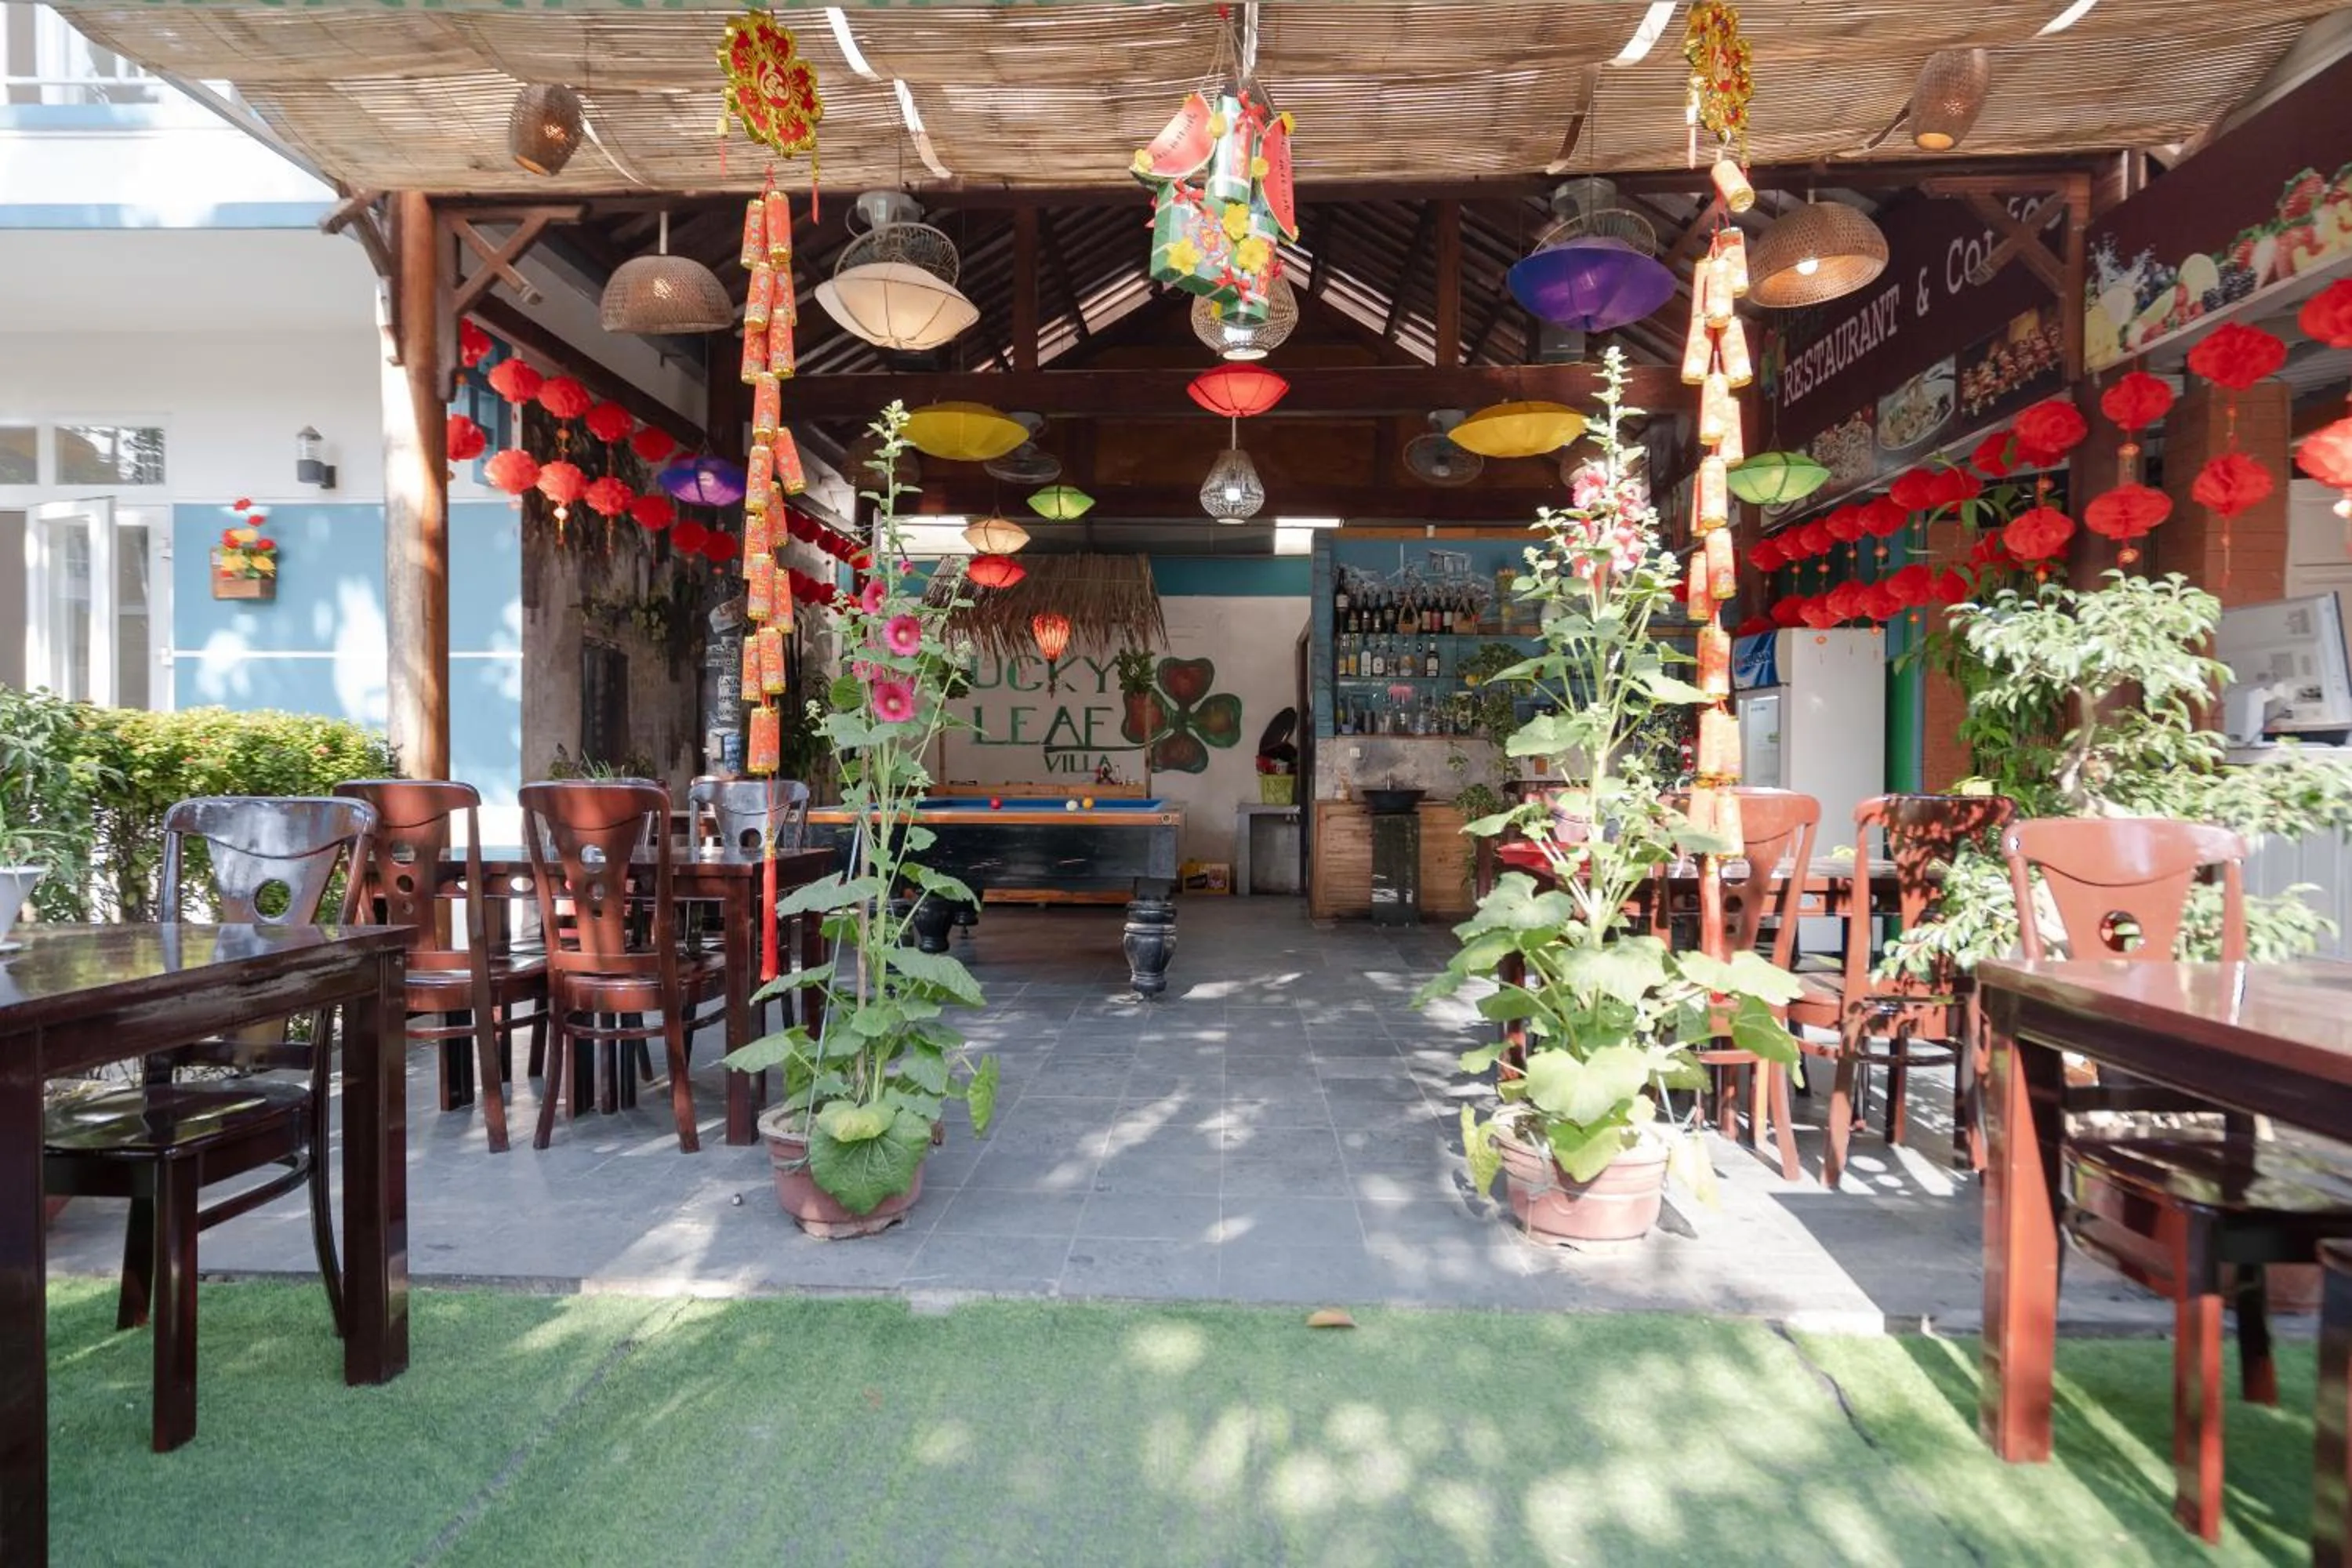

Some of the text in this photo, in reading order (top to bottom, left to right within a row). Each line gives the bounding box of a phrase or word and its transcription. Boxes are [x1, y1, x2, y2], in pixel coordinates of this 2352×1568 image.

[1784, 288, 1899, 406] RESTAURANT
[1917, 267, 1929, 317] &
[970, 655, 1120, 693] UCKY
[971, 706, 1112, 747] LEAF
[1044, 753, 1112, 773] VILLA
